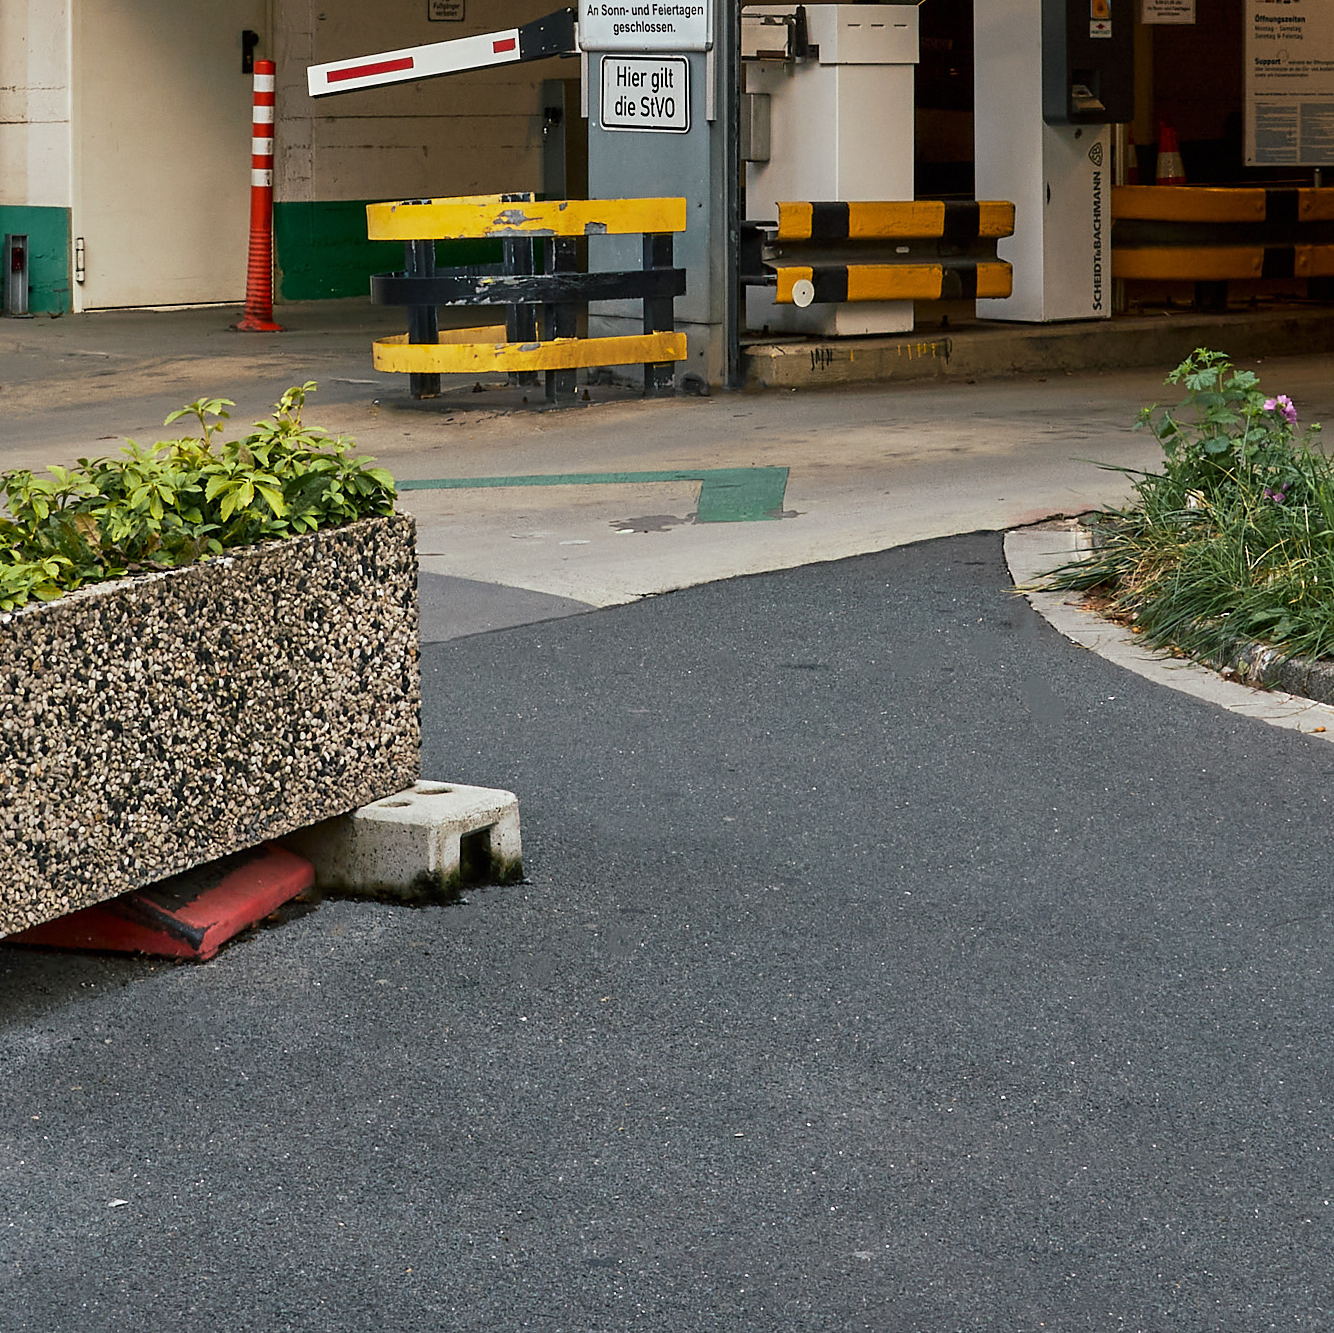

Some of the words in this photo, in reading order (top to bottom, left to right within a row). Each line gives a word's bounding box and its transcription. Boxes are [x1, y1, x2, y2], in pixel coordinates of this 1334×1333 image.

[587, 4, 599, 16] An
[601, 4, 629, 16] Sonn-
[631, 4, 650, 16] und
[652, 3, 704, 19] Feiertagen
[1255, 14, 1306, 24] Öffnungszeiten
[613, 20, 676, 36] geschlossen.
[1255, 58, 1281, 66] Support
[616, 65, 647, 88] Hier
[651, 66, 674, 94] gilt
[614, 95, 636, 117] die
[640, 96, 676, 119] StVO
